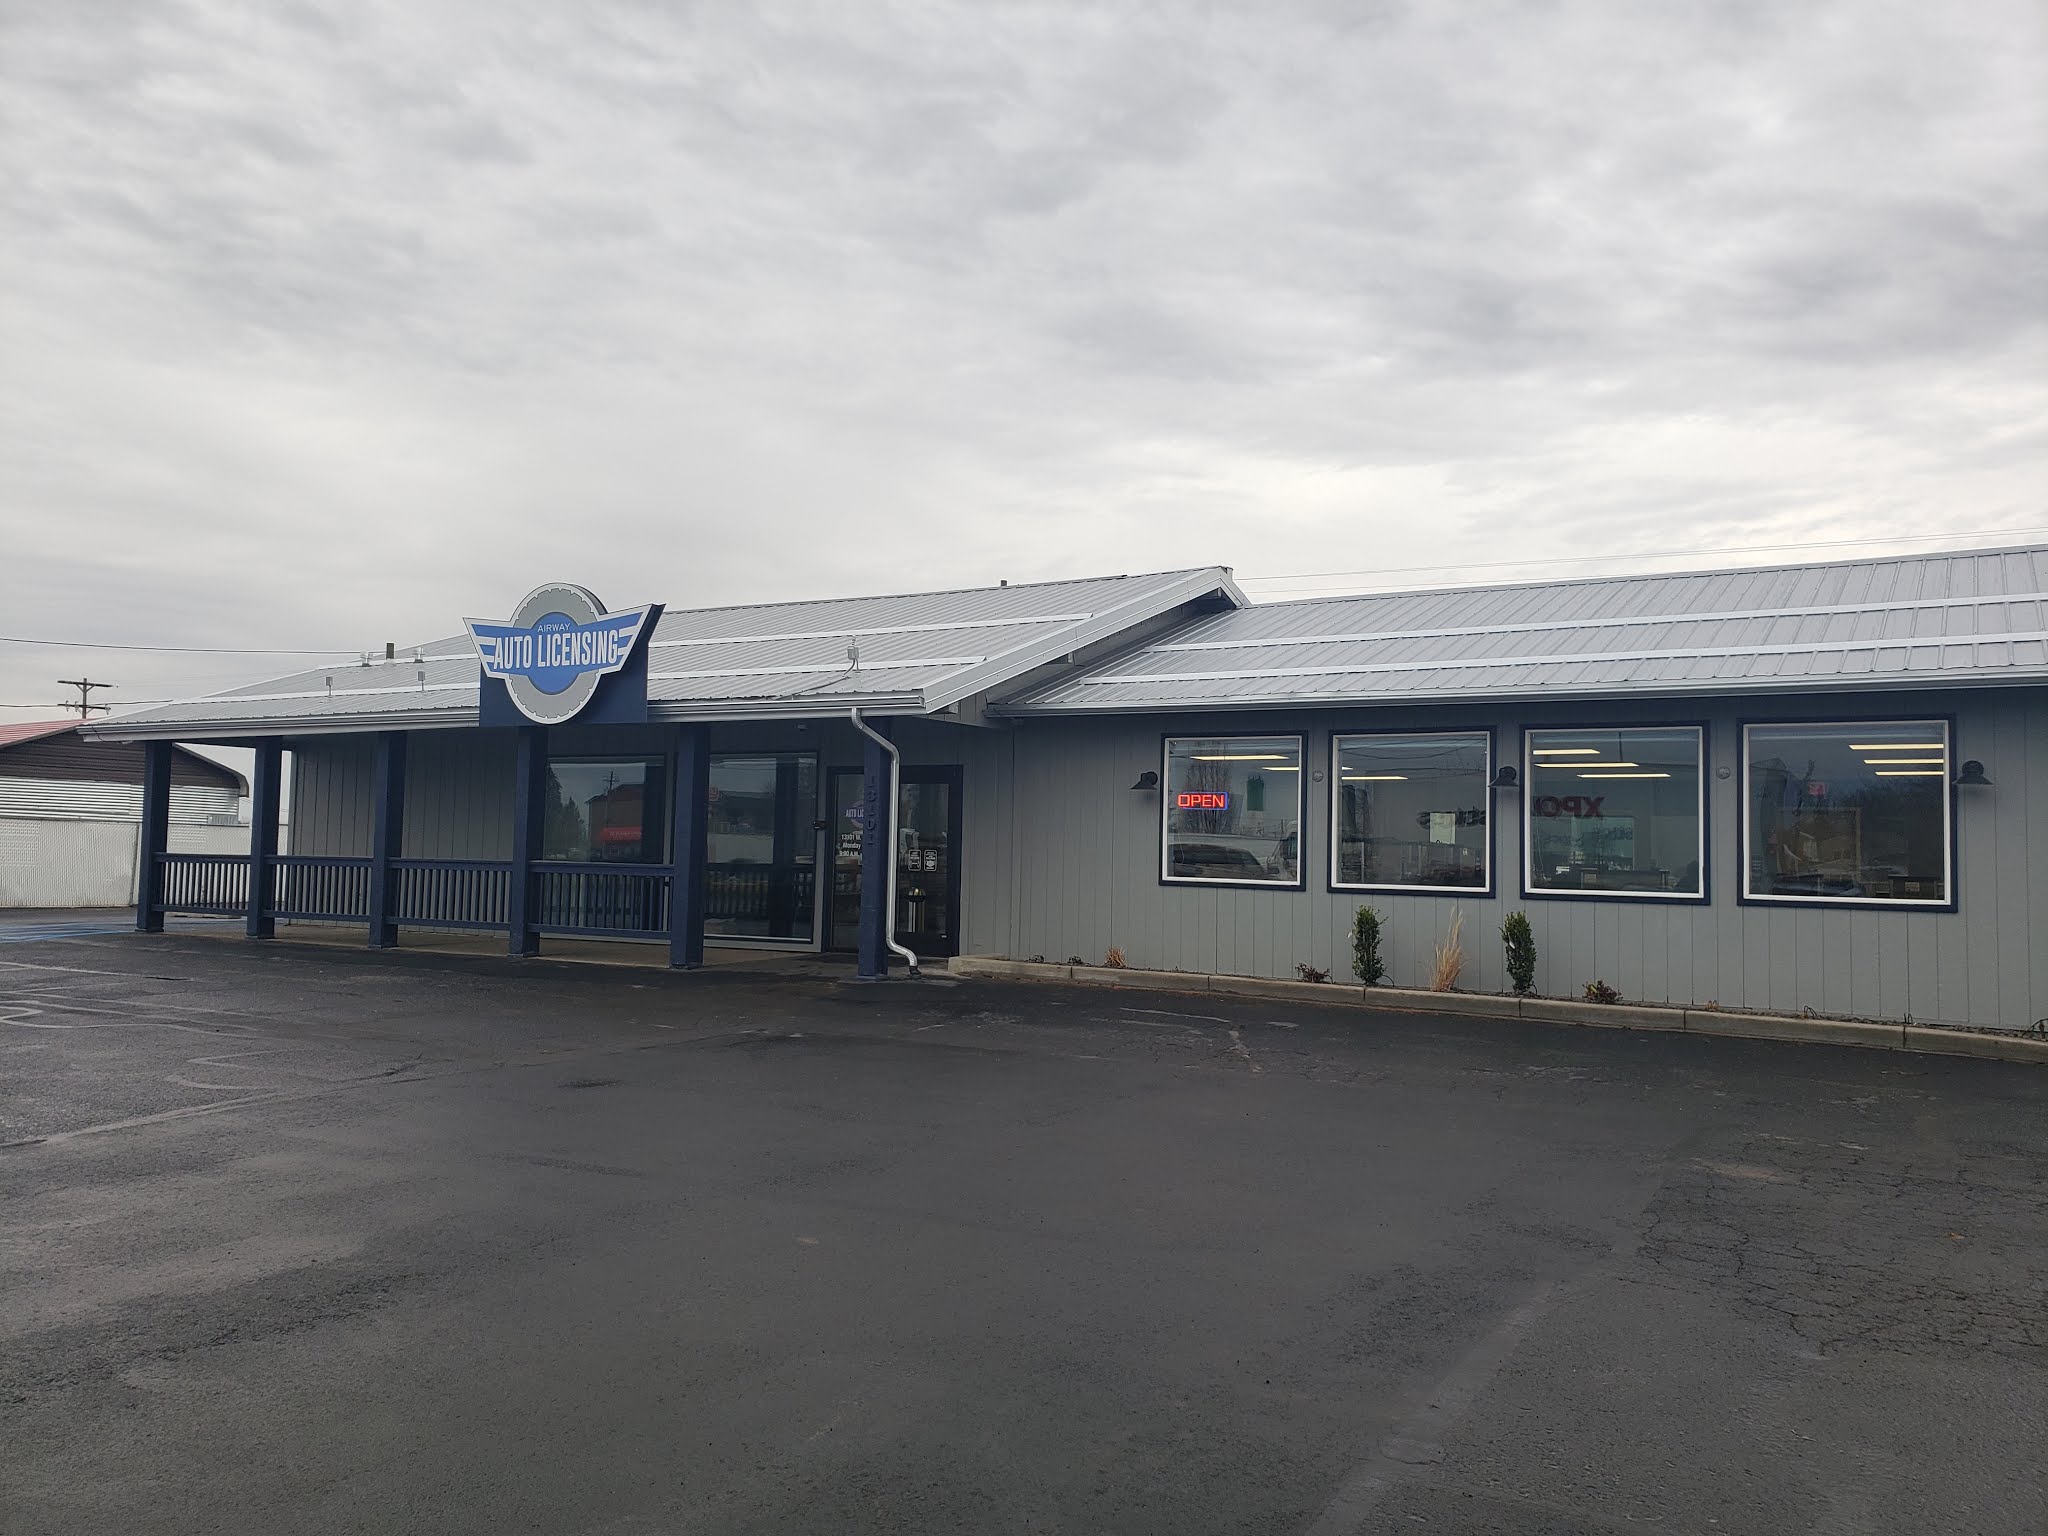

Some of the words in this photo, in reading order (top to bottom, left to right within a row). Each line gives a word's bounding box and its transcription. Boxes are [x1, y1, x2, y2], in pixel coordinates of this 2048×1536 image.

[537, 622, 571, 633] AIRWAY
[494, 635, 533, 670] AUTO
[538, 630, 619, 667] LICENSING
[1178, 794, 1225, 808] OPEN
